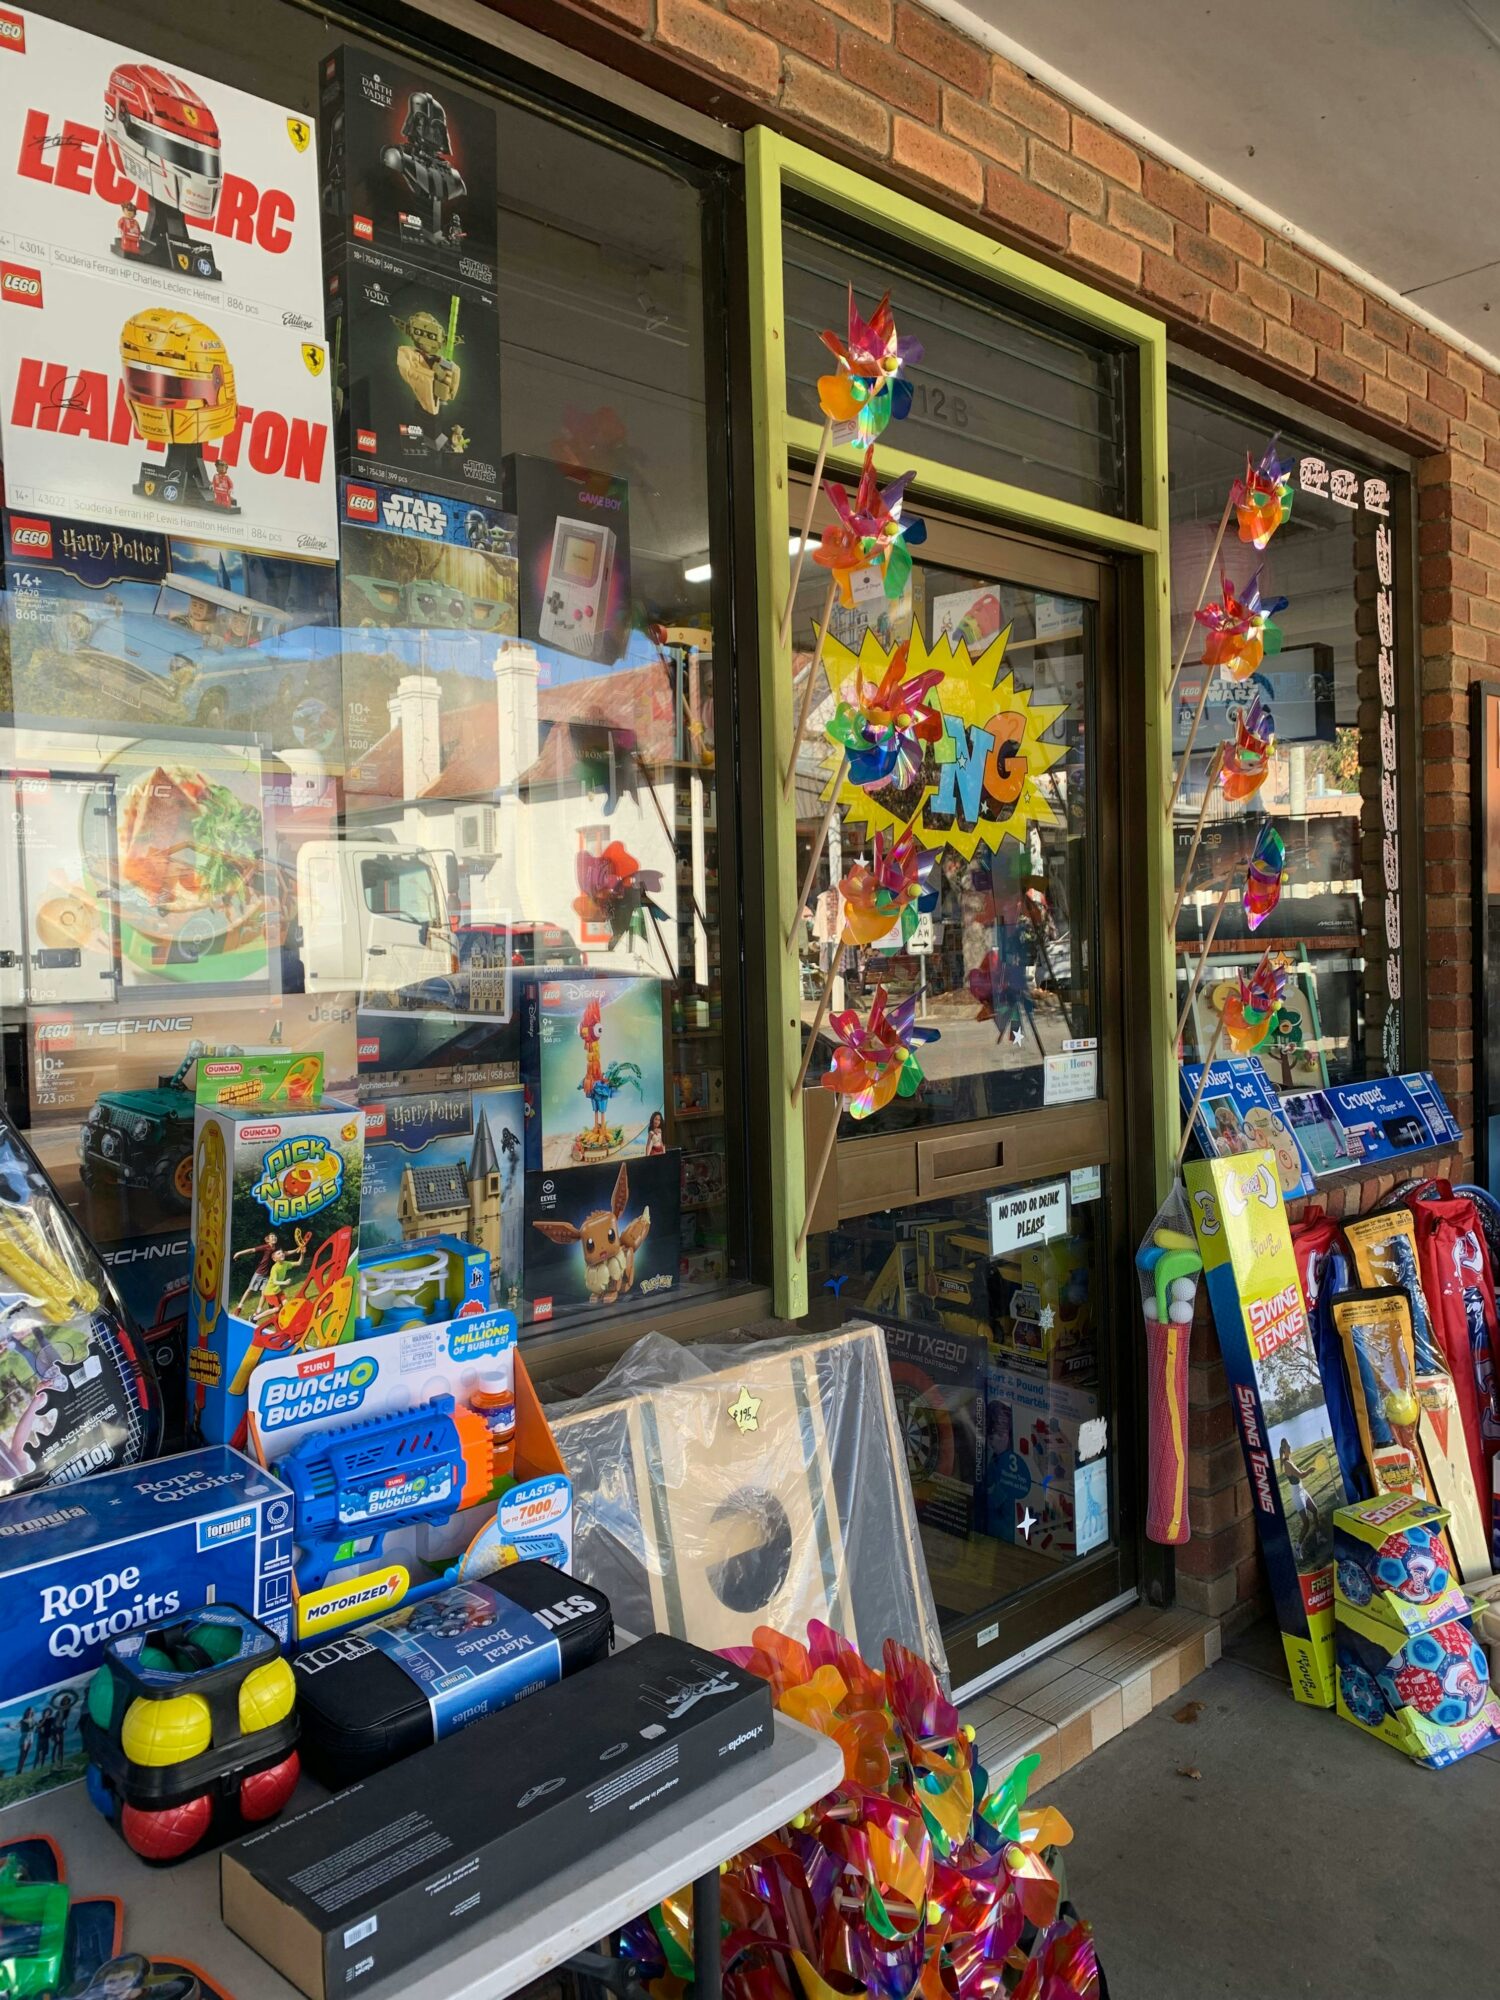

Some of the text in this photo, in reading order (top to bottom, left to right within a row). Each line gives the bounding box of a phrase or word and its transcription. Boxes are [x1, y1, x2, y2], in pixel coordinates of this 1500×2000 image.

[0, 21, 22, 39] EGO
[361, 76, 392, 98] DARTH
[363, 86, 392, 106] VADER
[355, 221, 372, 234] LEGO
[4, 273, 38, 296] LEGO
[19, 238, 259, 315] 43014 Scuderia Ferrari HP Charles Leclerc Helmet 886 pcs
[364, 288, 389, 304] YODA
[282, 311, 313, 329] Editions
[360, 435, 376, 446] LEGO
[463, 460, 496, 475] STAR
[464, 468, 496, 484] WARS
[349, 494, 376, 511] LEGO
[382, 493, 446, 519] STAR
[579, 491, 621, 512] GAME BOY
[38, 492, 282, 543] 43022 Scuderia Ferrari HP Lewis Hamilton Helmet 884 pcs
[383, 508, 447, 536] WARS
[13, 528, 49, 547] LEGO
[60, 528, 160, 564] Harry Potter
[297, 534, 327, 550] Editions
[13, 573, 42, 587] 14+
[16, 609, 37, 620] 868
[1181, 687, 1199, 697] LEGO
[1207, 689, 1258, 702] WARS
[348, 702, 371, 715] 10+
[349, 739, 368, 750] 1200
[61, 781, 172, 798] TECHNIC
[545, 990, 561, 1001] LEGO
[308, 1006, 351, 1025] Jeep
[543, 1018, 552, 1026] 9+
[37, 1017, 193, 1038] LEGO TECHNIC
[358, 1044, 378, 1056] LEGO
[36, 1058, 64, 1072] 10+
[208, 1065, 240, 1073] DUNCAN
[1070, 1058, 1093, 1069] Hours
[358, 1080, 399, 1091] Architecture
[468, 1071, 487, 1083] 21064
[1189, 1070, 1234, 1089] Hokey
[36, 1093, 75, 1104] 723 pcs
[1236, 1081, 1258, 1099] Set
[1339, 1085, 1386, 1111] Croquet
[364, 1115, 385, 1127] EGO
[392, 1098, 465, 1132] Harry Potter
[244, 1128, 277, 1137] DUNCAN
[272, 1180, 339, 1218] PASS
[540, 1194, 557, 1202] EEVEE
[999, 1205, 1008, 1221] NO
[1010, 1201, 1027, 1218] FOOD
[1029, 1197, 1038, 1211] OR
[1017, 1215, 1046, 1240] PLEASE
[101, 1241, 188, 1266] ECHNIC
[536, 1304, 552, 1314] LEGO
[1249, 1284, 1299, 1333] SWING
[454, 1324, 509, 1346] MILLIONS
[468, 1319, 496, 1332] BLAST
[1256, 1309, 1304, 1359] TENNIS
[453, 1335, 509, 1356] OF BUBBLES!
[918, 1336, 968, 1364] TX290
[303, 1361, 330, 1373] ZURU
[1017, 1379, 1044, 1395] Pound
[266, 1389, 359, 1427] Bubbles
[61, 1403, 115, 1443] BADMINTON
[84, 1409, 118, 1434] DELUXE
[40, 1442, 61, 1458] SET
[43, 1436, 78, 1463] PLAYER
[1236, 1385, 1276, 1515] SWING TENNIS
[1009, 1454, 1018, 1472] 3
[133, 1468, 205, 1496] Rope
[154, 1470, 245, 1504] Quoits
[388, 1478, 403, 1486] ZURU
[514, 1481, 556, 1504] BLASTS
[369, 1493, 419, 1513] Bubbles
[1361, 1495, 1418, 1526] SOCCER
[503, 1518, 512, 1526] UP
[519, 1500, 551, 1520] 7000
[521, 1514, 546, 1527] BUBBLES
[207, 1515, 251, 1538] formula
[1311, 1576, 1331, 1593] FREE
[40, 1566, 140, 1624] Rope
[306, 1583, 388, 1621] MOTORIZED
[49, 1590, 180, 1658] Quoits
[456, 1627, 514, 1657] Boules
[486, 1633, 534, 1663] Metal
[452, 1699, 489, 1726] Boules
